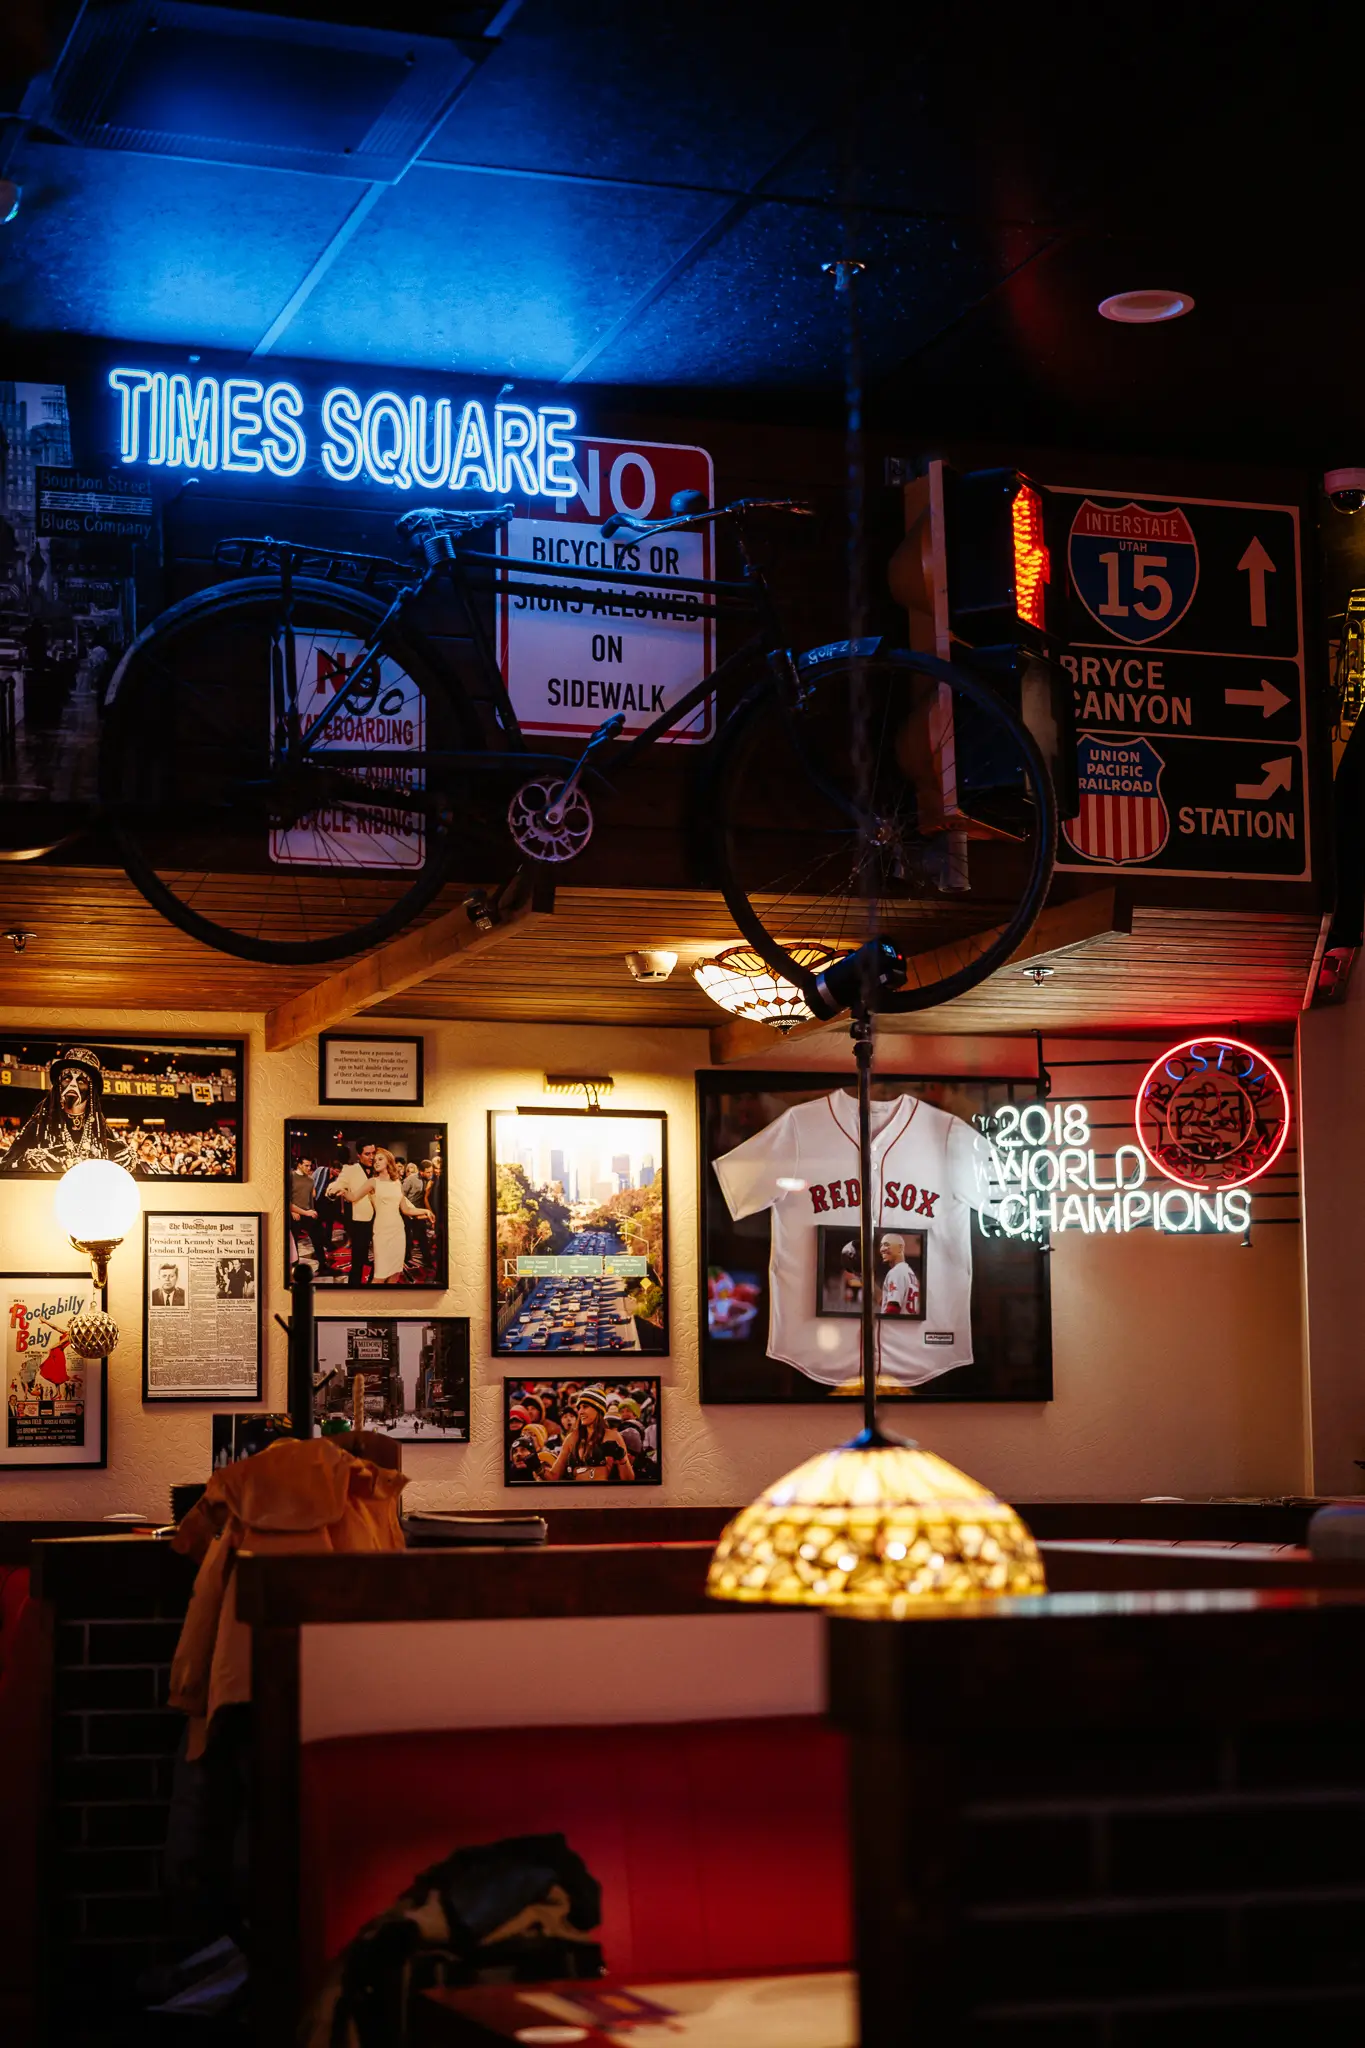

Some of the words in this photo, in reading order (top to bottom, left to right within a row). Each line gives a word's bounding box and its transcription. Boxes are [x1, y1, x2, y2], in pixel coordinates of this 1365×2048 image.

[109, 368, 307, 477] TIMES
[321, 386, 578, 498] SQUARE
[41, 470, 103, 490] Bourbon
[107, 474, 151, 494] Street
[555, 447, 657, 520] NO
[40, 511, 80, 532] Blues
[83, 514, 151, 539] Company
[1085, 512, 1179, 538] INTERSTATE
[532, 536, 641, 571] BICYCLES
[650, 546, 680, 575] OR
[1119, 540, 1147, 553] UTAH
[1098, 551, 1173, 621] 15
[591, 587, 698, 622] ALLOWED
[591, 634, 623, 663] ON
[1060, 654, 1165, 691] BRYCE
[547, 678, 666, 713] SIDEWALK
[1086, 764, 1143, 778] PACIFIC
[1089, 749, 1141, 764] UNION
[1078, 777, 1152, 793] RAILROAD
[355, 807, 413, 837] RIDING
[1178, 806, 1296, 840] STATION
[115, 1081, 131, 1094] ON
[135, 1082, 157, 1095] THE
[160, 1083, 175, 1097] 29
[995, 1104, 1091, 1146] 2018
[991, 1145, 1146, 1191] WORLD
[808, 1178, 861, 1214] RED
[884, 1181, 940, 1218] SOX
[999, 1189, 1252, 1234] CHAMPIONS
[219, 1223, 234, 1232] Post
[149, 1247, 175, 1255] Lyndon
[184, 1238, 214, 1247] Kennedy
[9, 1296, 85, 1331] Rockabilly
[16, 1328, 52, 1352] Baby
[347, 1328, 388, 1337] SONY
